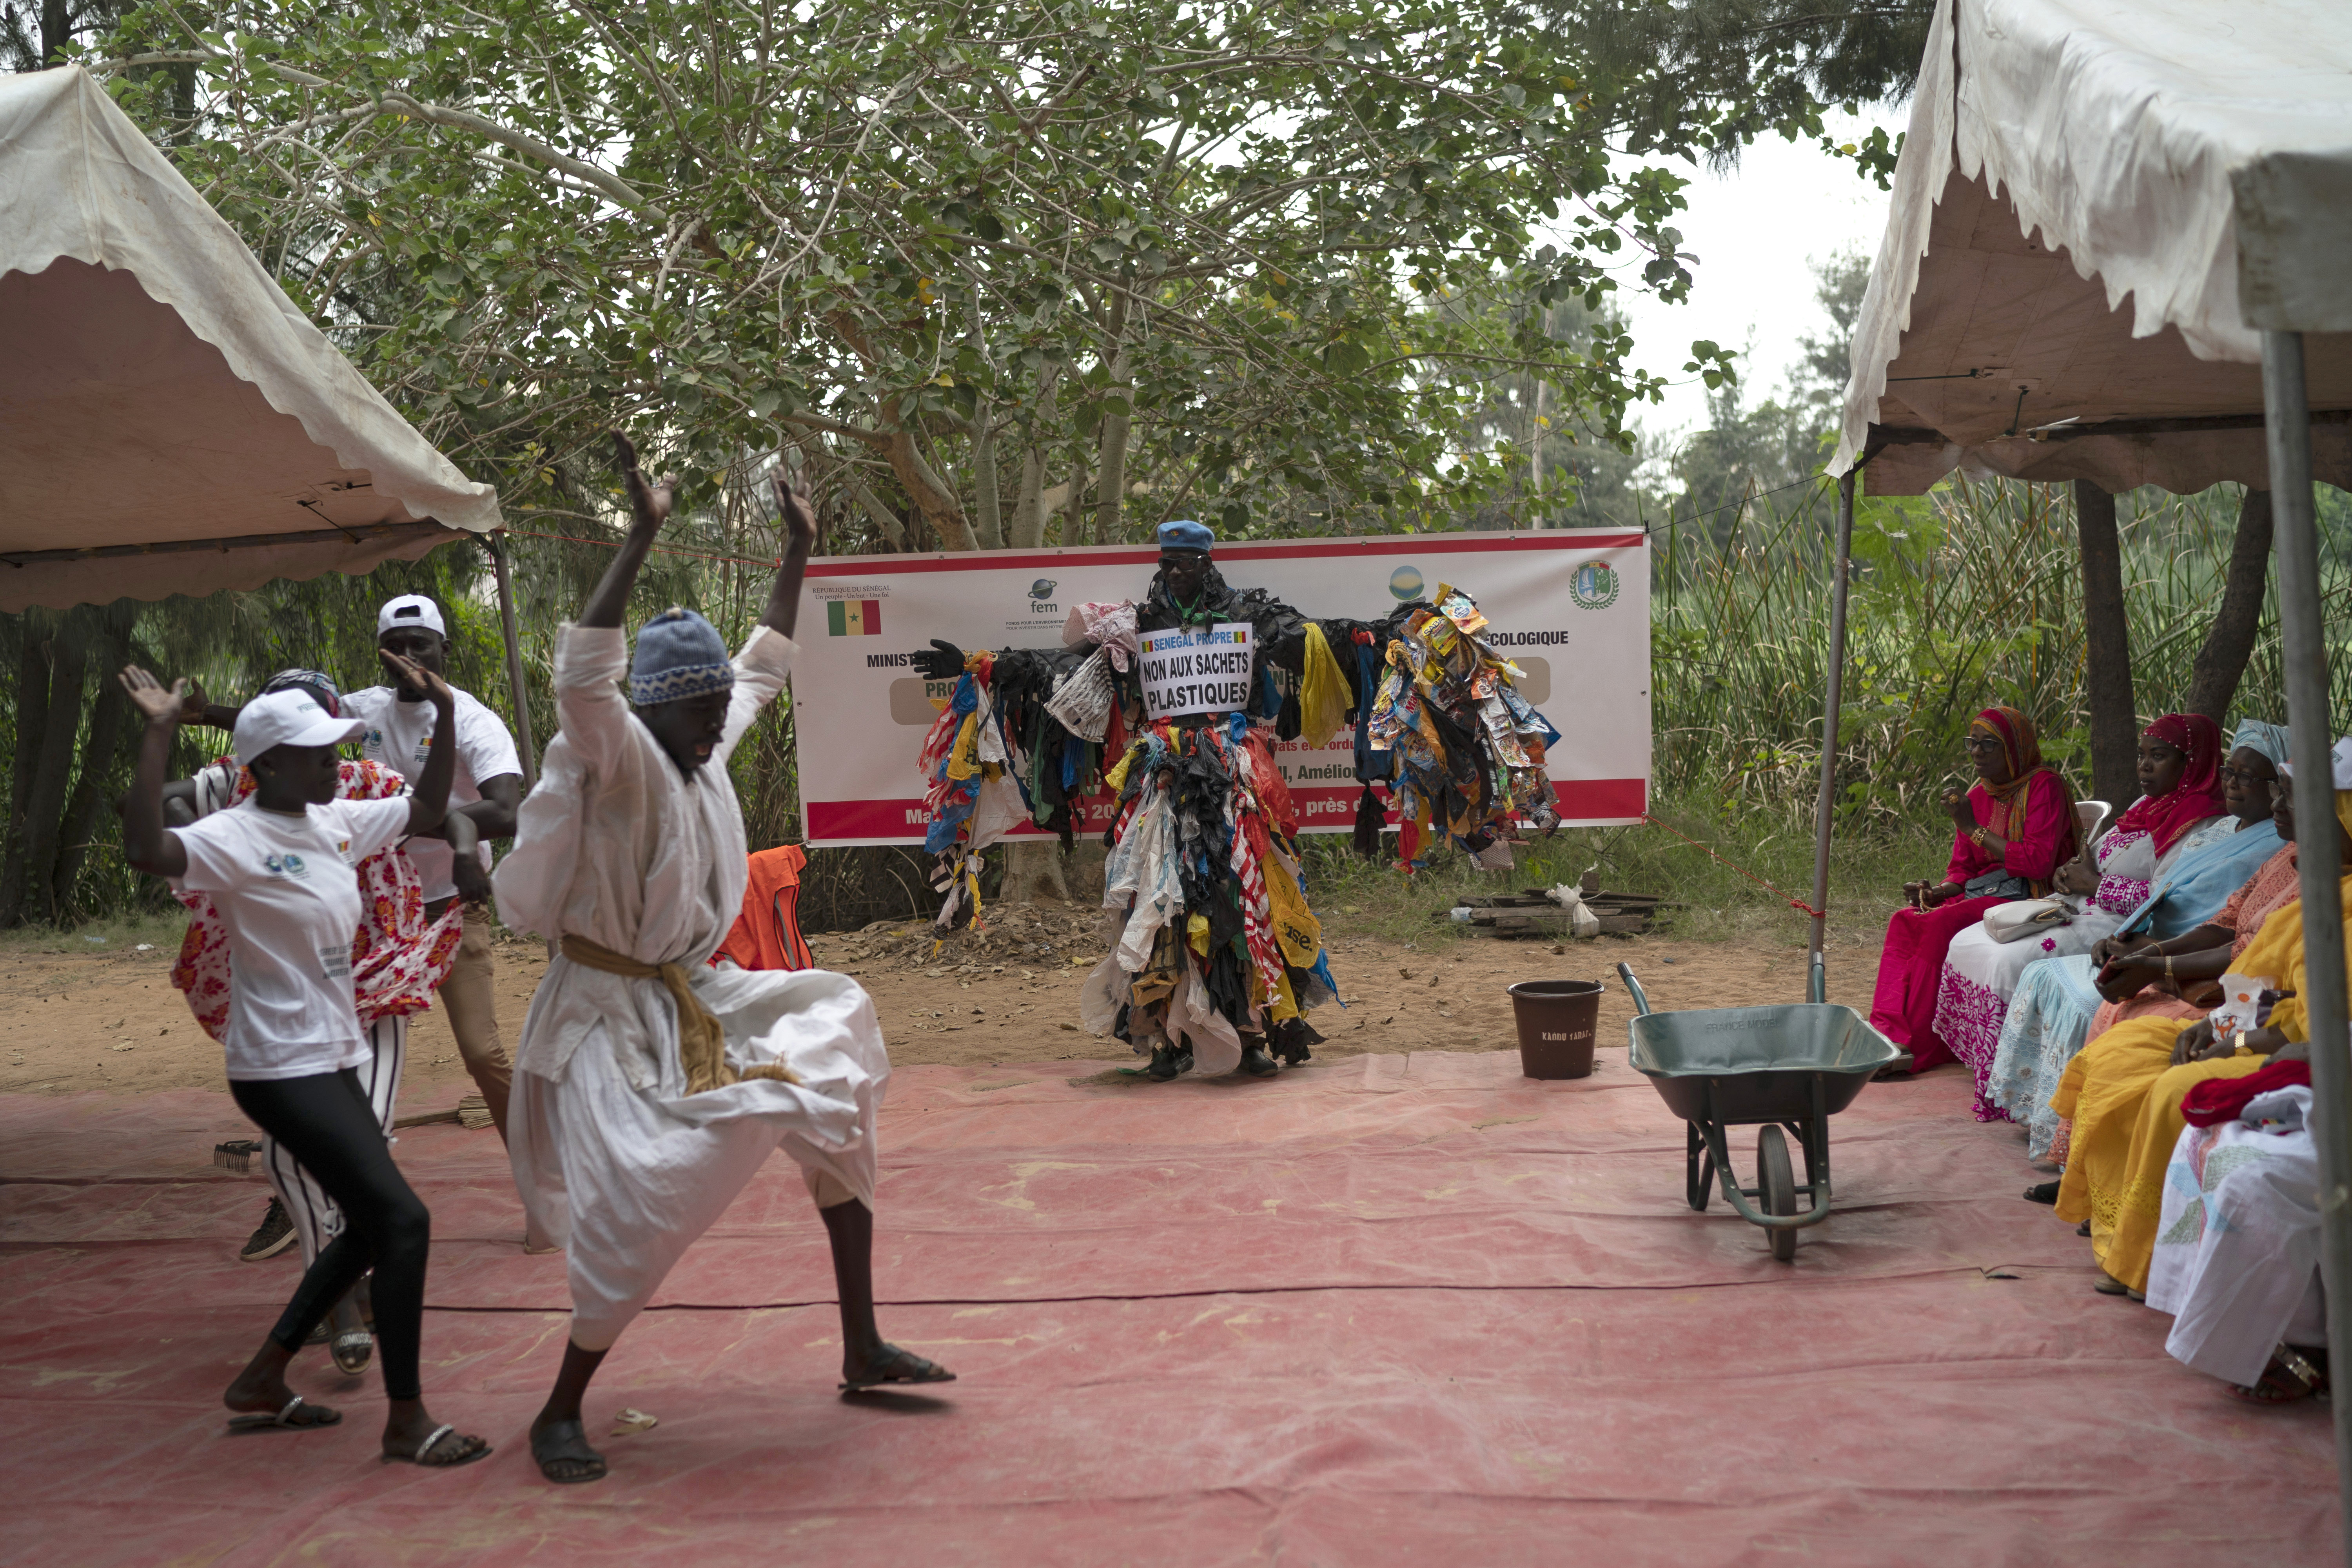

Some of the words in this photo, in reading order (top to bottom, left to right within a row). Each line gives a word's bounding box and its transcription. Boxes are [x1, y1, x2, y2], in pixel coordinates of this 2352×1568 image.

[1031, 601, 1058, 613] fem
[1424, 617, 1445, 636] SABA
[867, 653, 916, 667] MINIST
[1486, 631, 1568, 646] COLOGIQUE
[1154, 634, 1194, 651] SENEGAL
[1196, 631, 1232, 646] PROPRE
[1143, 659, 1167, 683] NON
[1170, 655, 1193, 679] AUX
[1196, 652, 1248, 675] SACHETS
[1147, 682, 1247, 712] PLASTIQUES
[1298, 764, 1356, 780] Amélior
[1306, 797, 1347, 817] près
[1705, 1020, 1744, 1032] FRANCE
[1747, 1018, 1780, 1029] MODEL
[1542, 1031, 1566, 1041] KADDU
